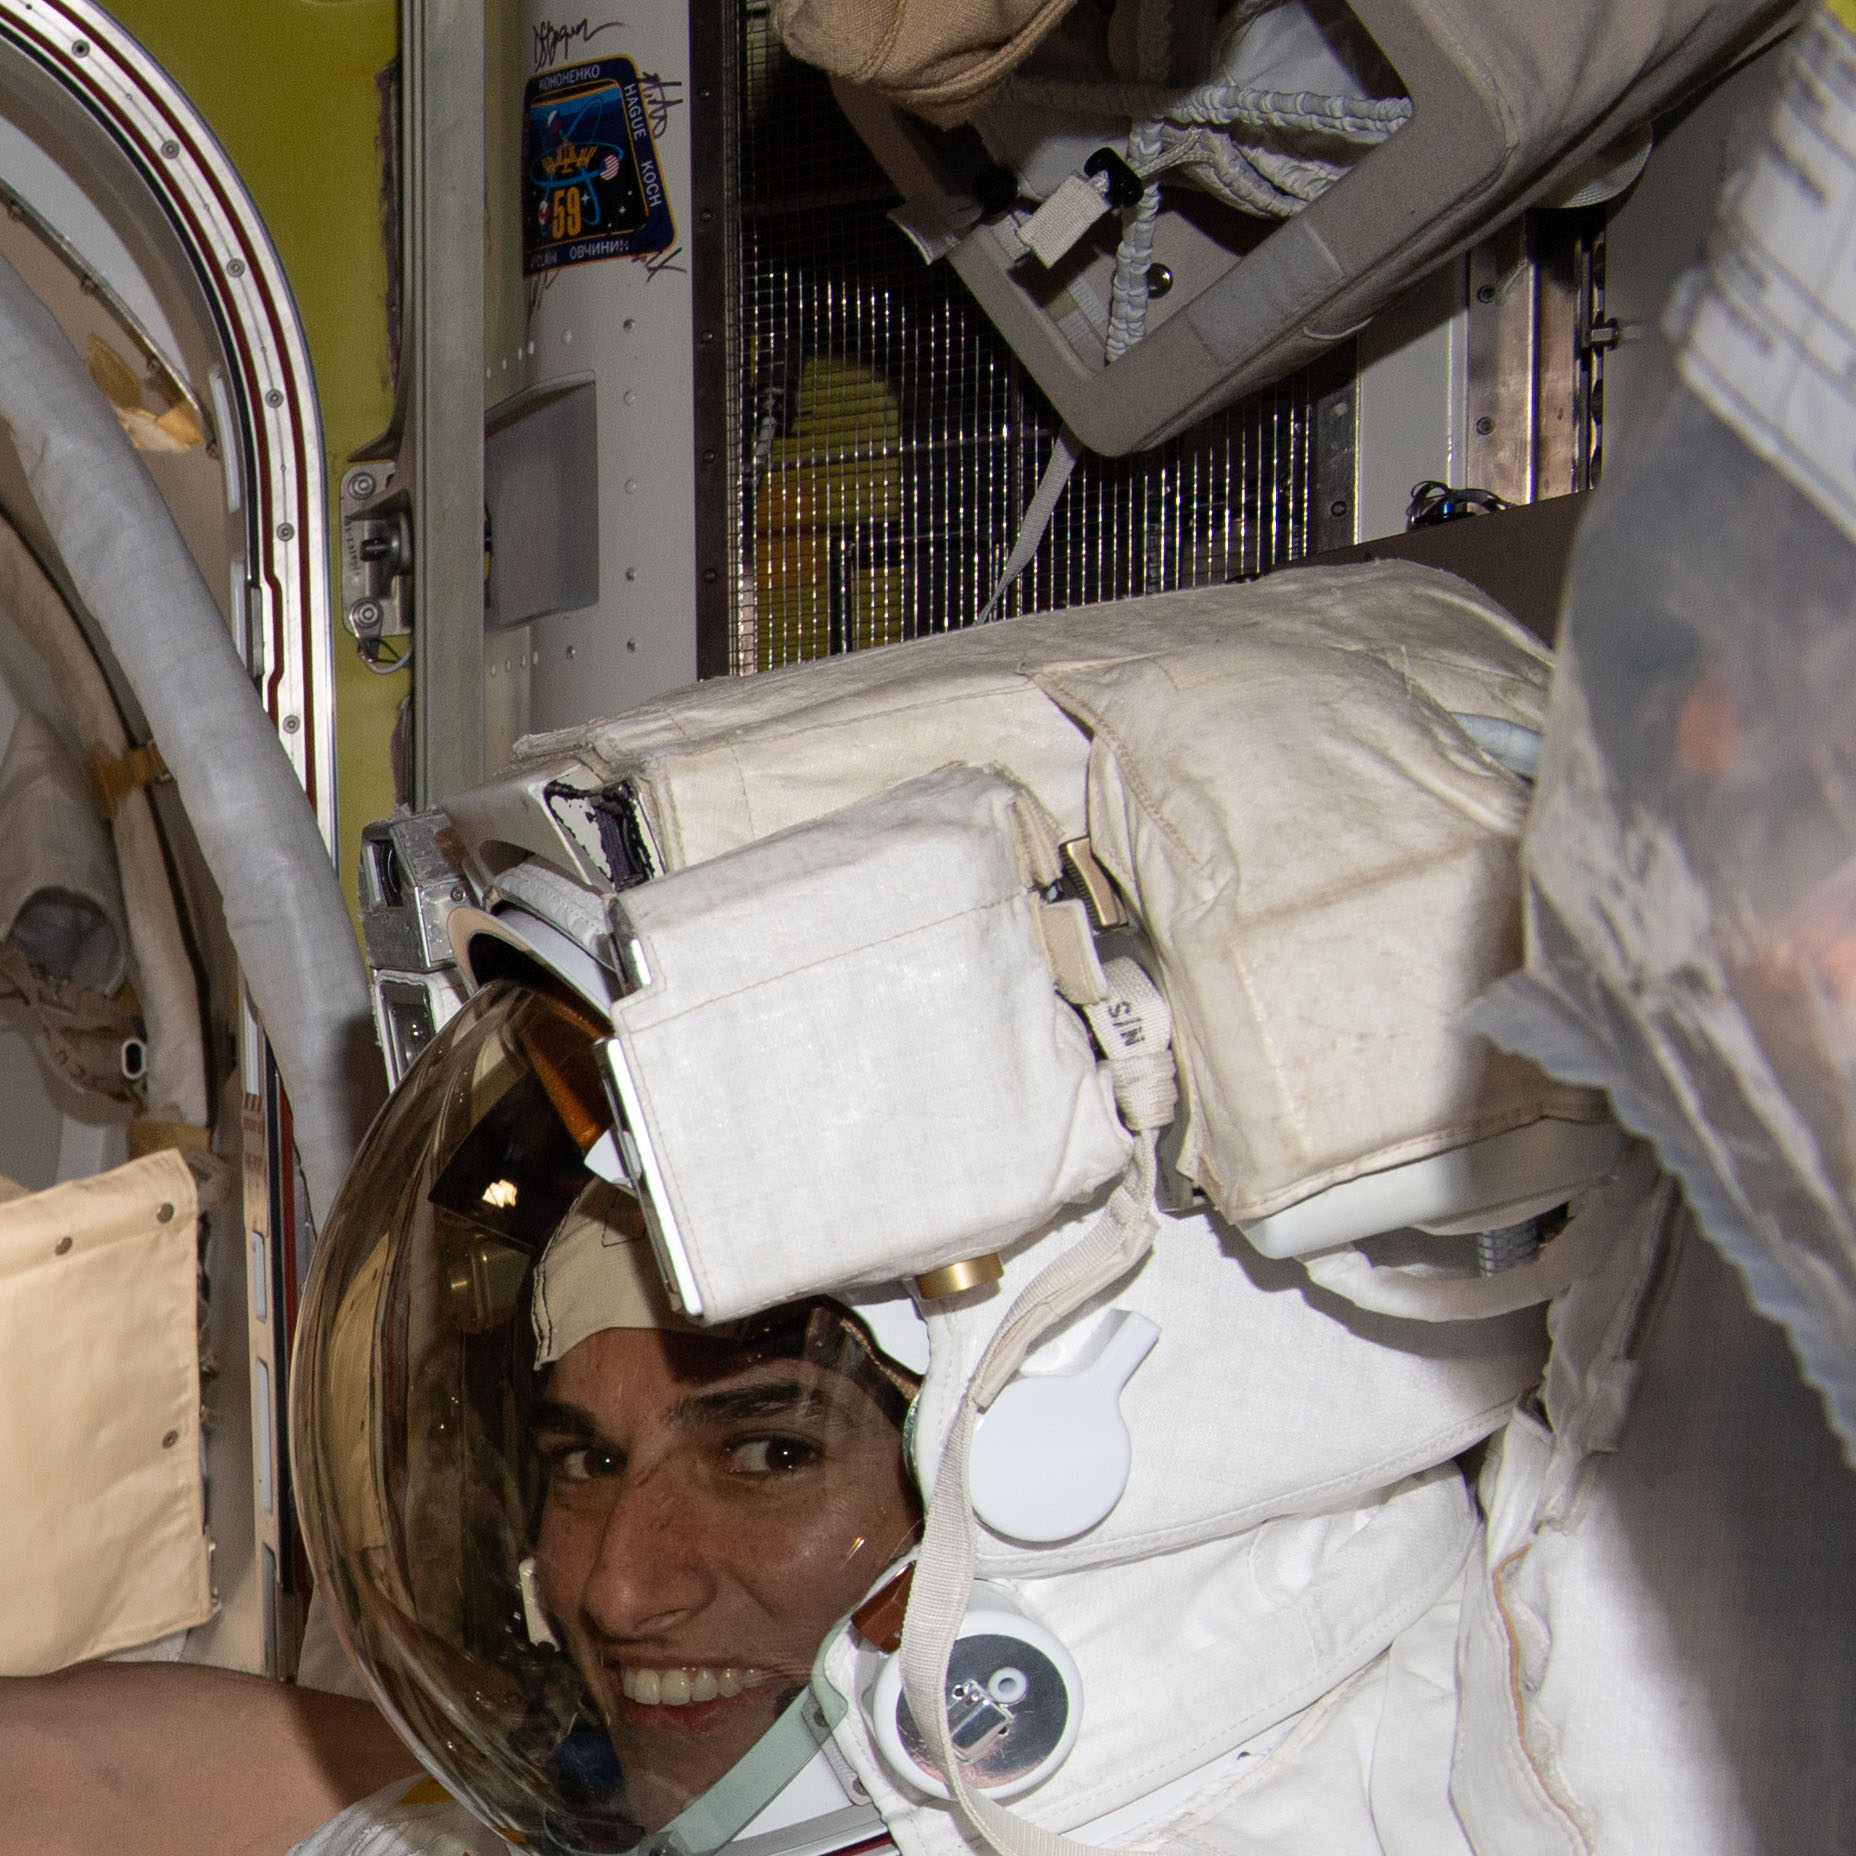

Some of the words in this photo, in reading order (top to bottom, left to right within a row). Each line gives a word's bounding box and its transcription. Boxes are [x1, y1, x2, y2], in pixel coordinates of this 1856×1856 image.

[624, 83, 647, 141] HAGUE
[640, 160, 662, 207] KOCH
[552, 187, 582, 239] 59
